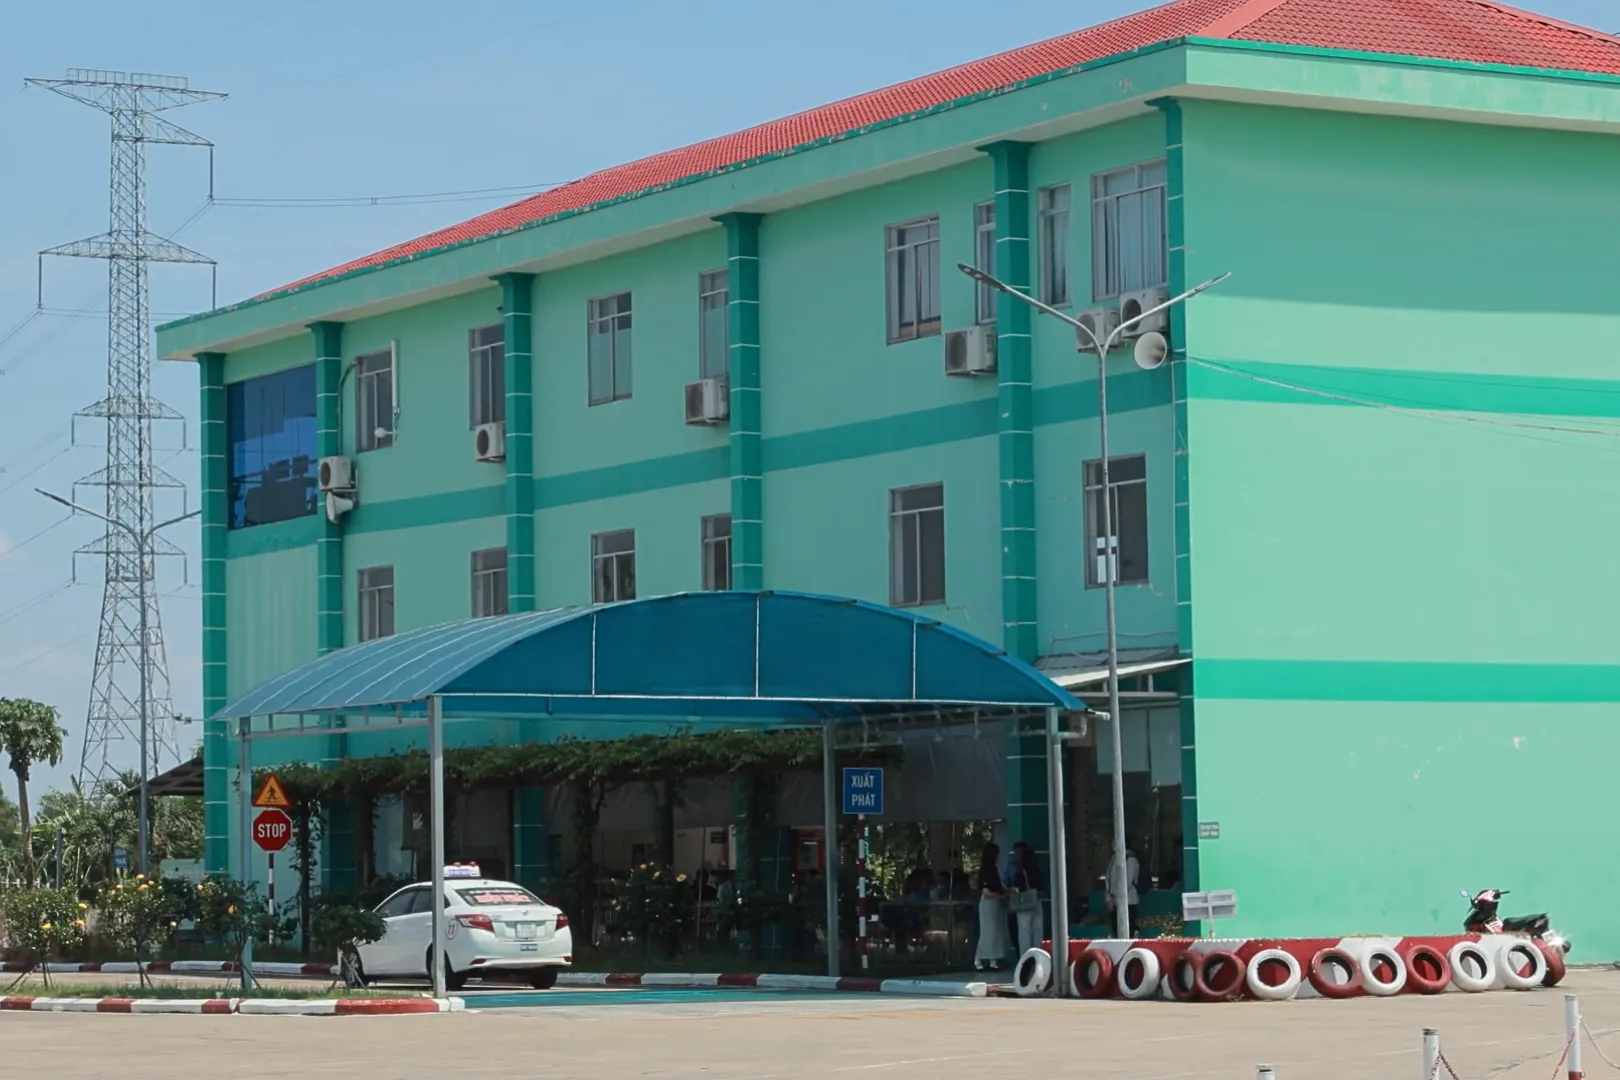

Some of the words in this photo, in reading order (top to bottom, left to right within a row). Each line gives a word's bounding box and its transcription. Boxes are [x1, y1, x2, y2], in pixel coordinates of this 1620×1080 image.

[851, 771, 875, 788] XUẤT
[851, 792, 876, 807] PHÁT
[258, 823, 286, 838] STOP
